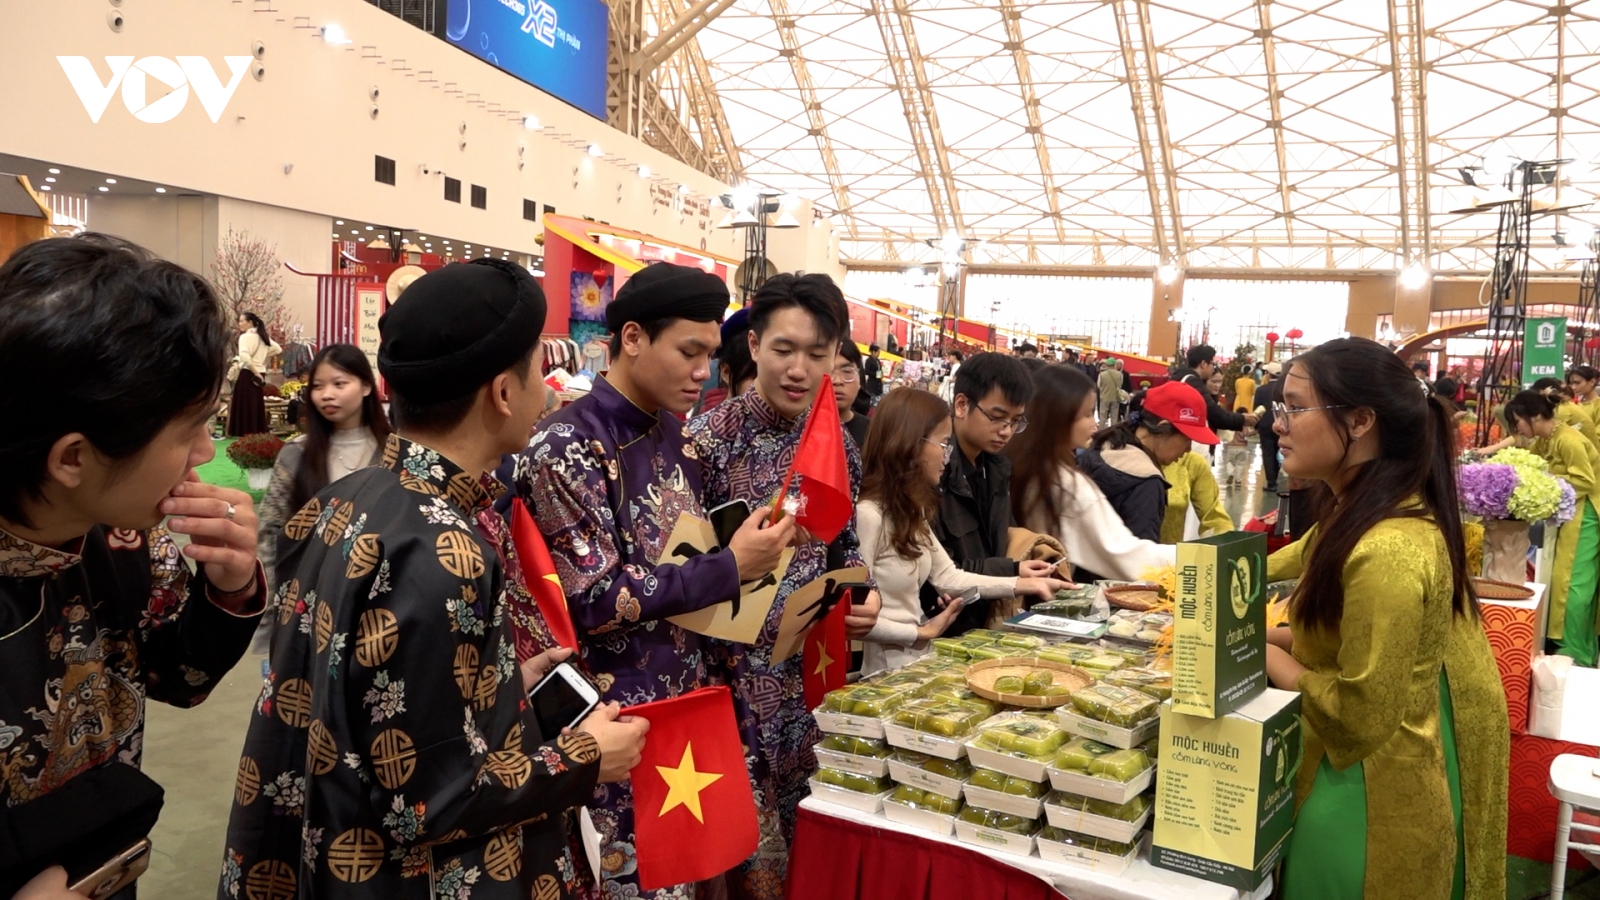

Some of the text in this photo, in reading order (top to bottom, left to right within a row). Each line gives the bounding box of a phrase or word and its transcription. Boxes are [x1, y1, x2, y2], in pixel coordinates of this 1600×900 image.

[520, 0, 557, 48] X2
[1531, 366, 1555, 375] KEM
[1178, 565, 1197, 595] HUYỀN
[1179, 597, 1198, 619] MỘC
[1172, 735, 1239, 759] MỘC HUYỀN
